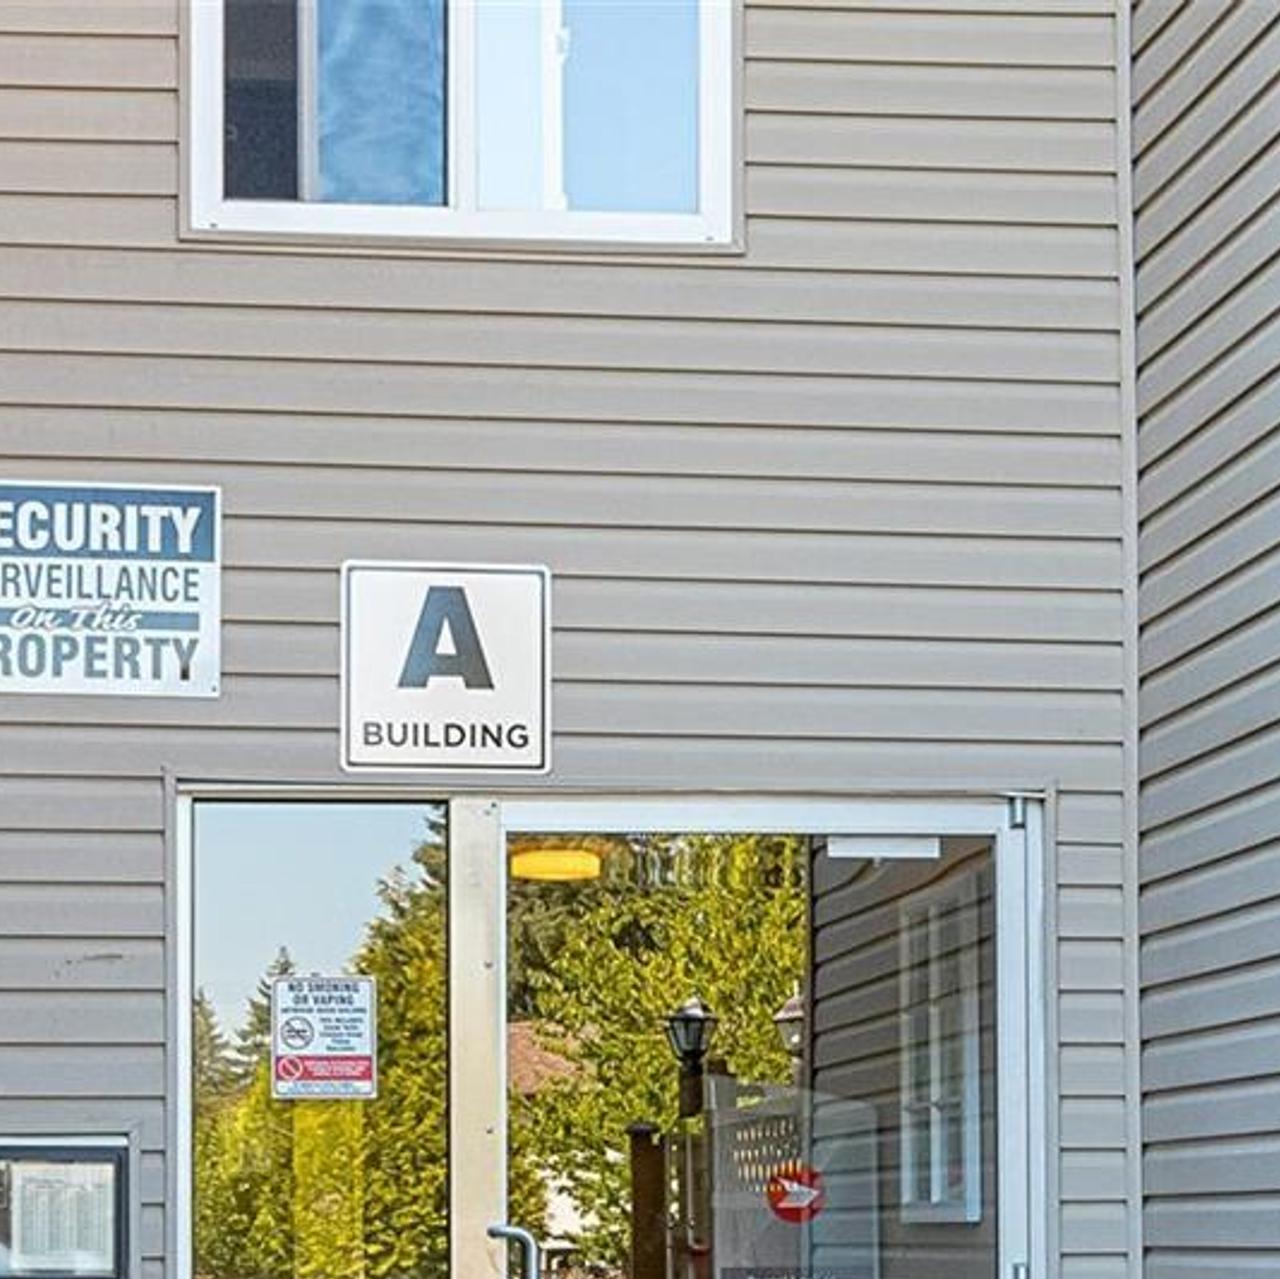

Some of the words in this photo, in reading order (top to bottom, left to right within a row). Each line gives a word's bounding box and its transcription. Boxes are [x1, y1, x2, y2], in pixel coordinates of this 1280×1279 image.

[9, 604, 62, 630] On
[70, 599, 143, 633] This
[398, 586, 495, 690] A
[363, 721, 529, 748] BUILDING
